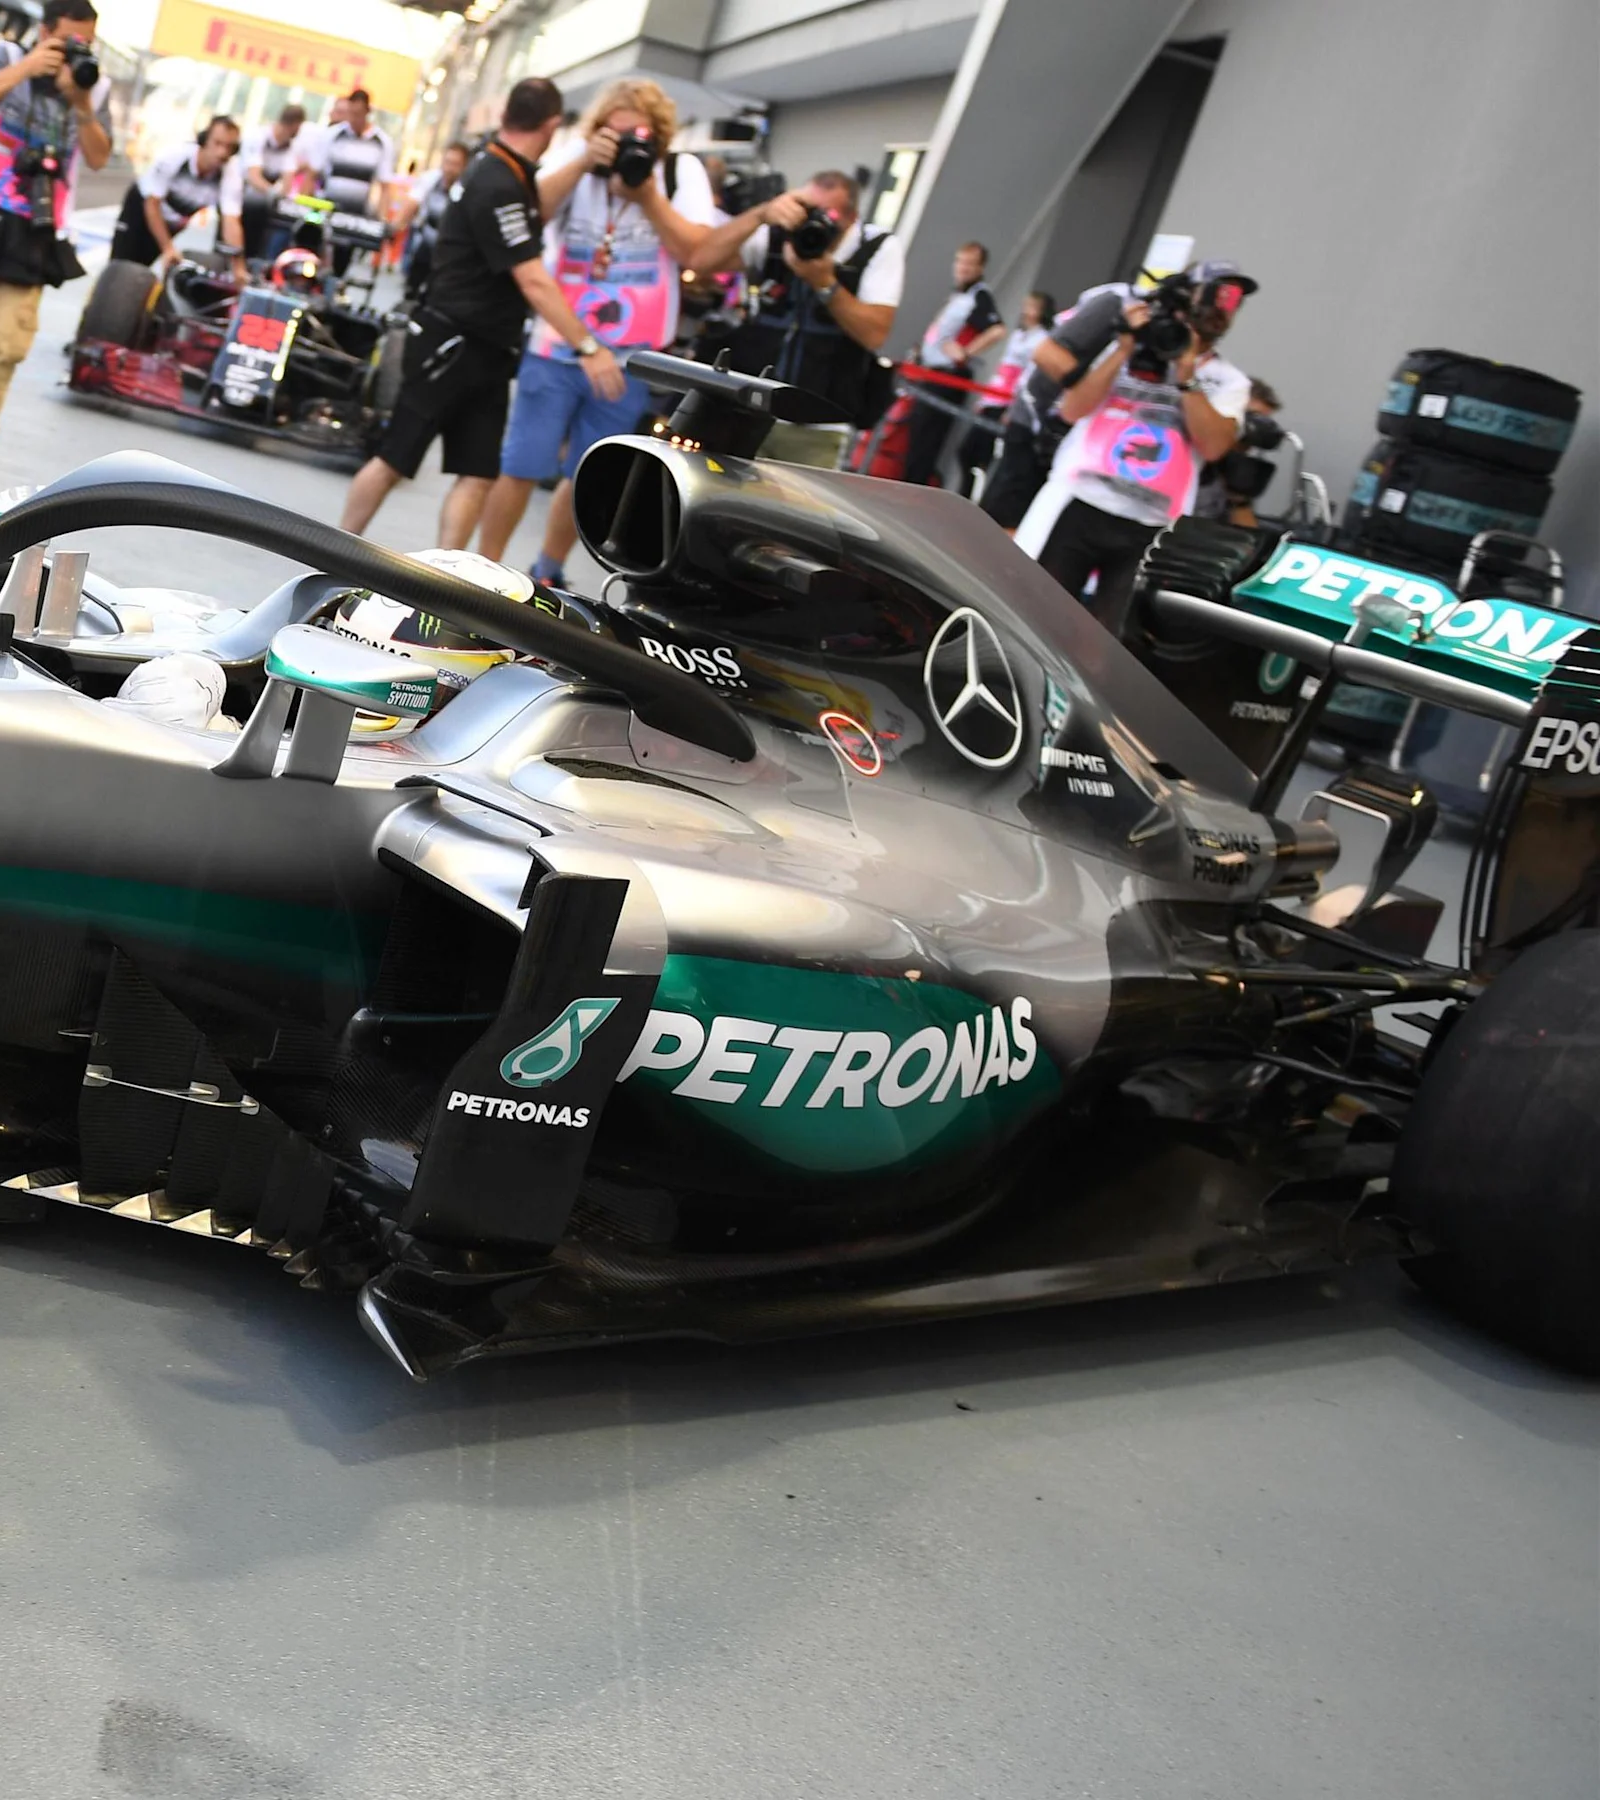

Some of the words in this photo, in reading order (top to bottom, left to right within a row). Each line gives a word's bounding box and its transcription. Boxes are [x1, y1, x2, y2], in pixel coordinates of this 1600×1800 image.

[204, 18, 371, 92] PIRELLI
[391, 682, 432, 693] PETRONAS
[437, 668, 472, 687] EPSON
[387, 691, 430, 708] SYNTIUM
[617, 995, 1034, 1109] PETRONAS
[446, 1090, 591, 1129] PETRONAS
